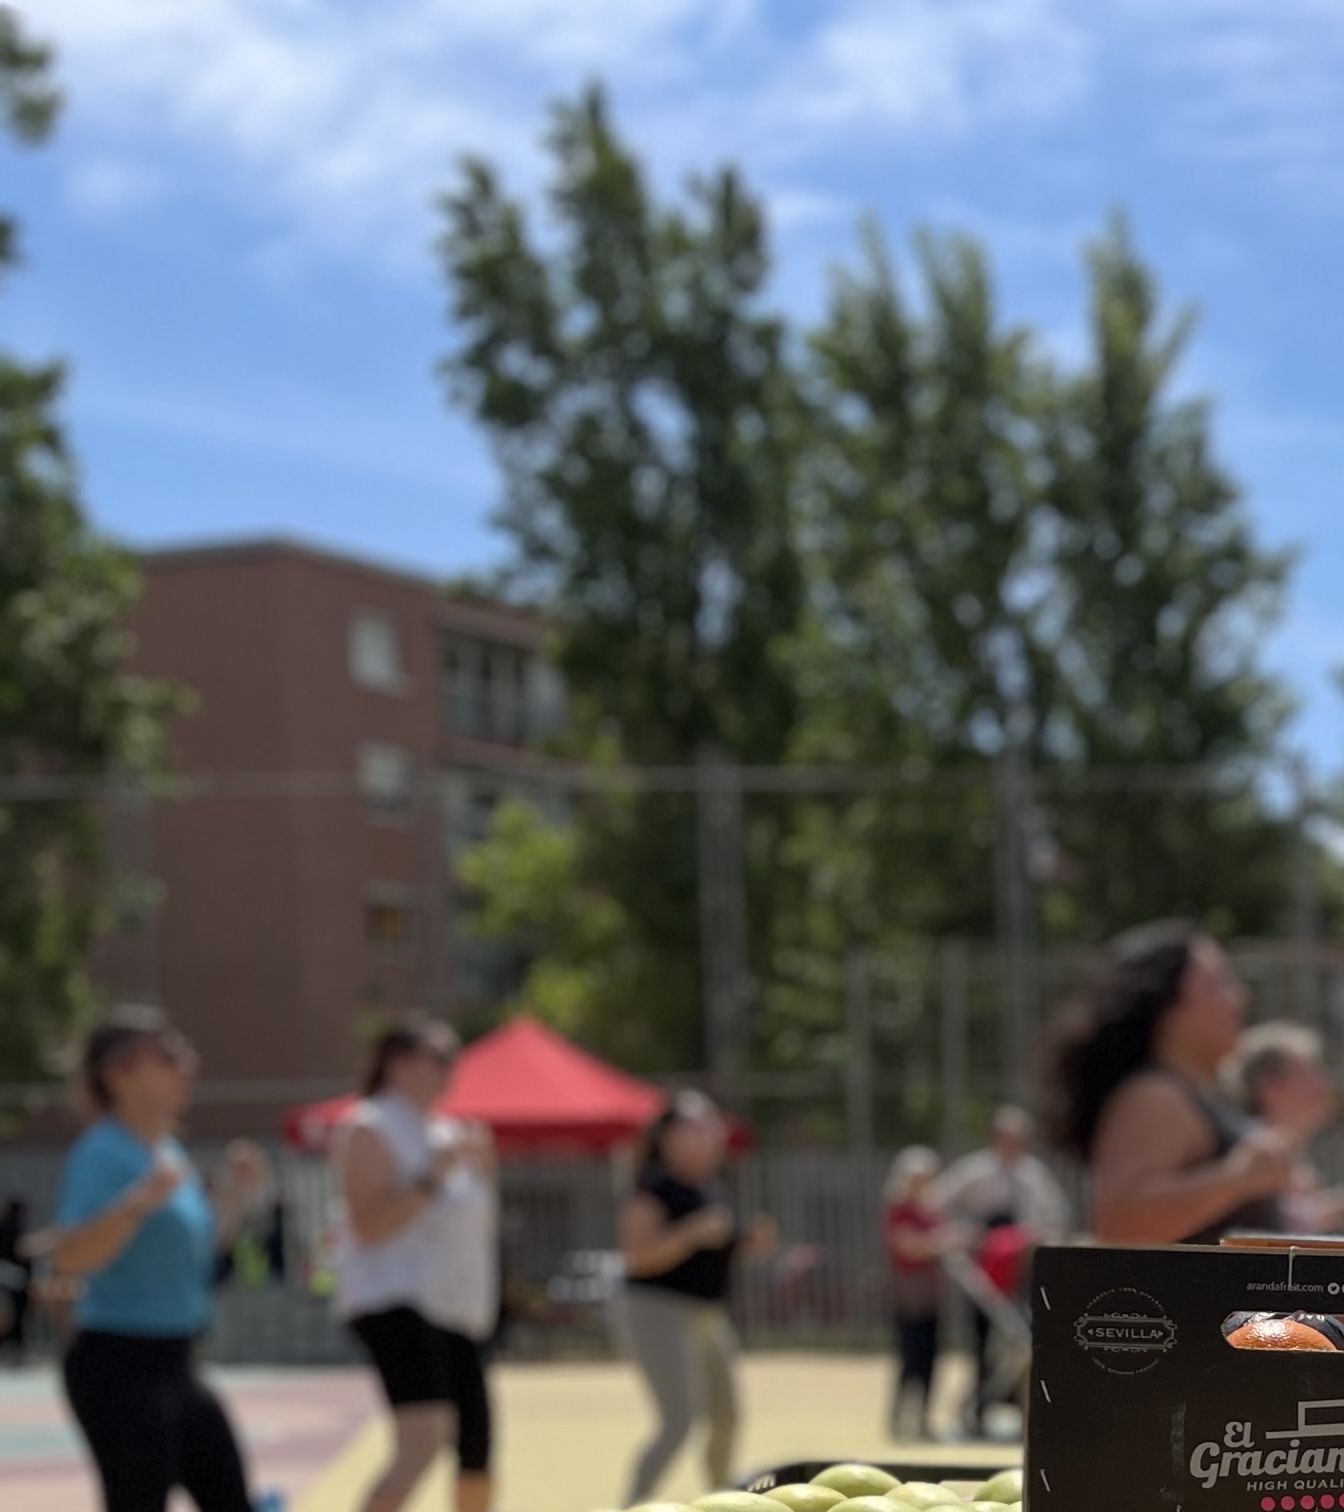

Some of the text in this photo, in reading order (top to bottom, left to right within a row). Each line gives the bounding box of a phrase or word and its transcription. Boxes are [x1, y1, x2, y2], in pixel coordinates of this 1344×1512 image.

[1095, 1327, 1159, 1340] SEVILLA
[1223, 1421, 1255, 1448] El
[1246, 1480, 1288, 1492] HIGH
